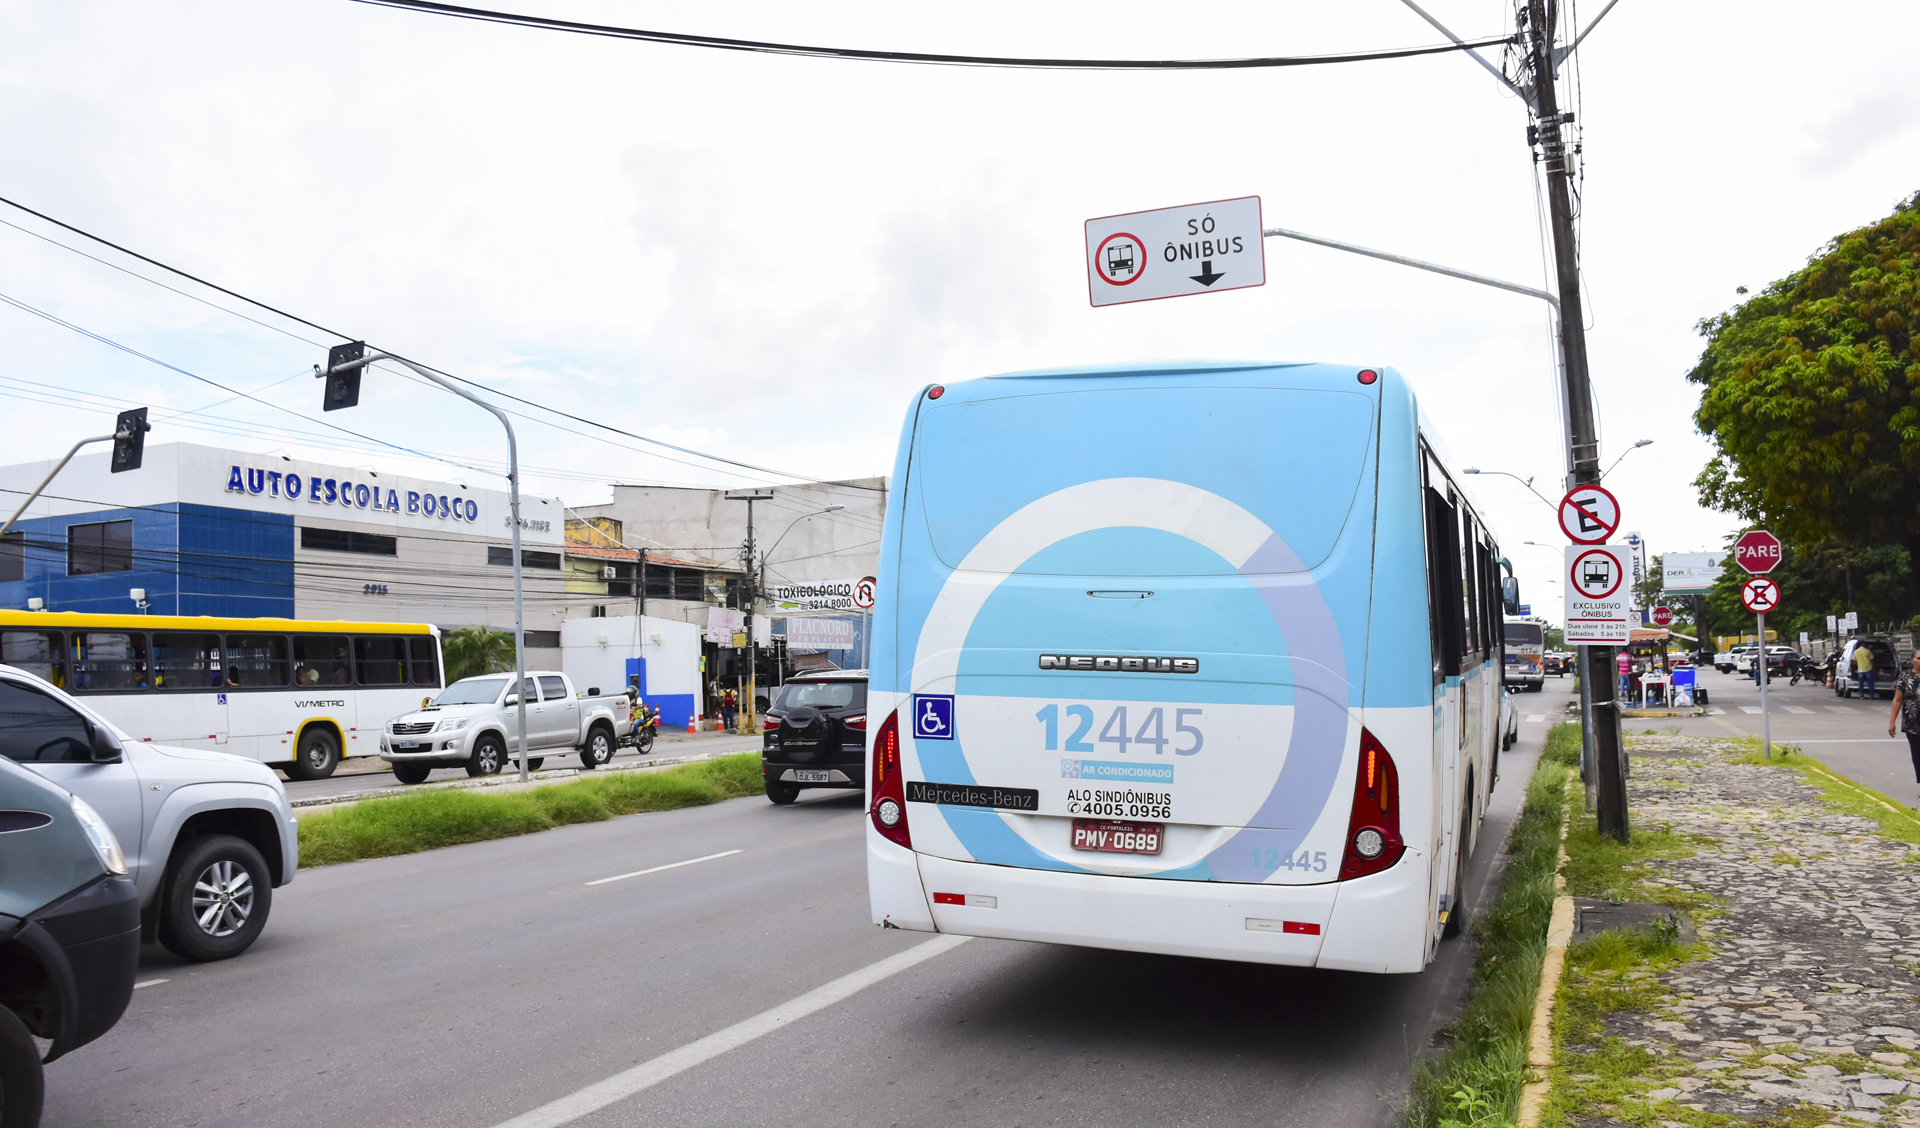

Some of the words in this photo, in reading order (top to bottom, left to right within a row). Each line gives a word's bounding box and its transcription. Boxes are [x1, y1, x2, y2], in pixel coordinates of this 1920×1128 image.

[1187, 213, 1216, 236] SÓ
[1163, 236, 1244, 262] ÔNIBUS
[225, 465, 302, 500] AUTO
[308, 476, 401, 514] ESCOLA
[405, 490, 479, 523] BOSCO
[1575, 497, 1603, 533] E
[1737, 544, 1779, 558] PARE
[777, 582, 851, 599] TOXICOLÓGICO
[808, 598, 852, 610] 3214.8000
[1573, 602, 1621, 610] EXCLUSIVO
[1581, 609, 1613, 618] ÔNIBUS
[1653, 612, 1672, 620] PARE
[792, 618, 850, 636] PLACNORD
[1040, 654, 1199, 673] NEOBUS
[1035, 704, 1204, 756] 12445
[1082, 765, 1096, 774] AR
[1097, 766, 1172, 778] CONDICIONADO
[912, 784, 1032, 808] Mercedes-Benz
[1067, 789, 1092, 801] ALO
[1094, 788, 1172, 805] SINDIÔNIBUS
[1082, 802, 1171, 818] 4005.0956
[1250, 847, 1328, 873] 12445
